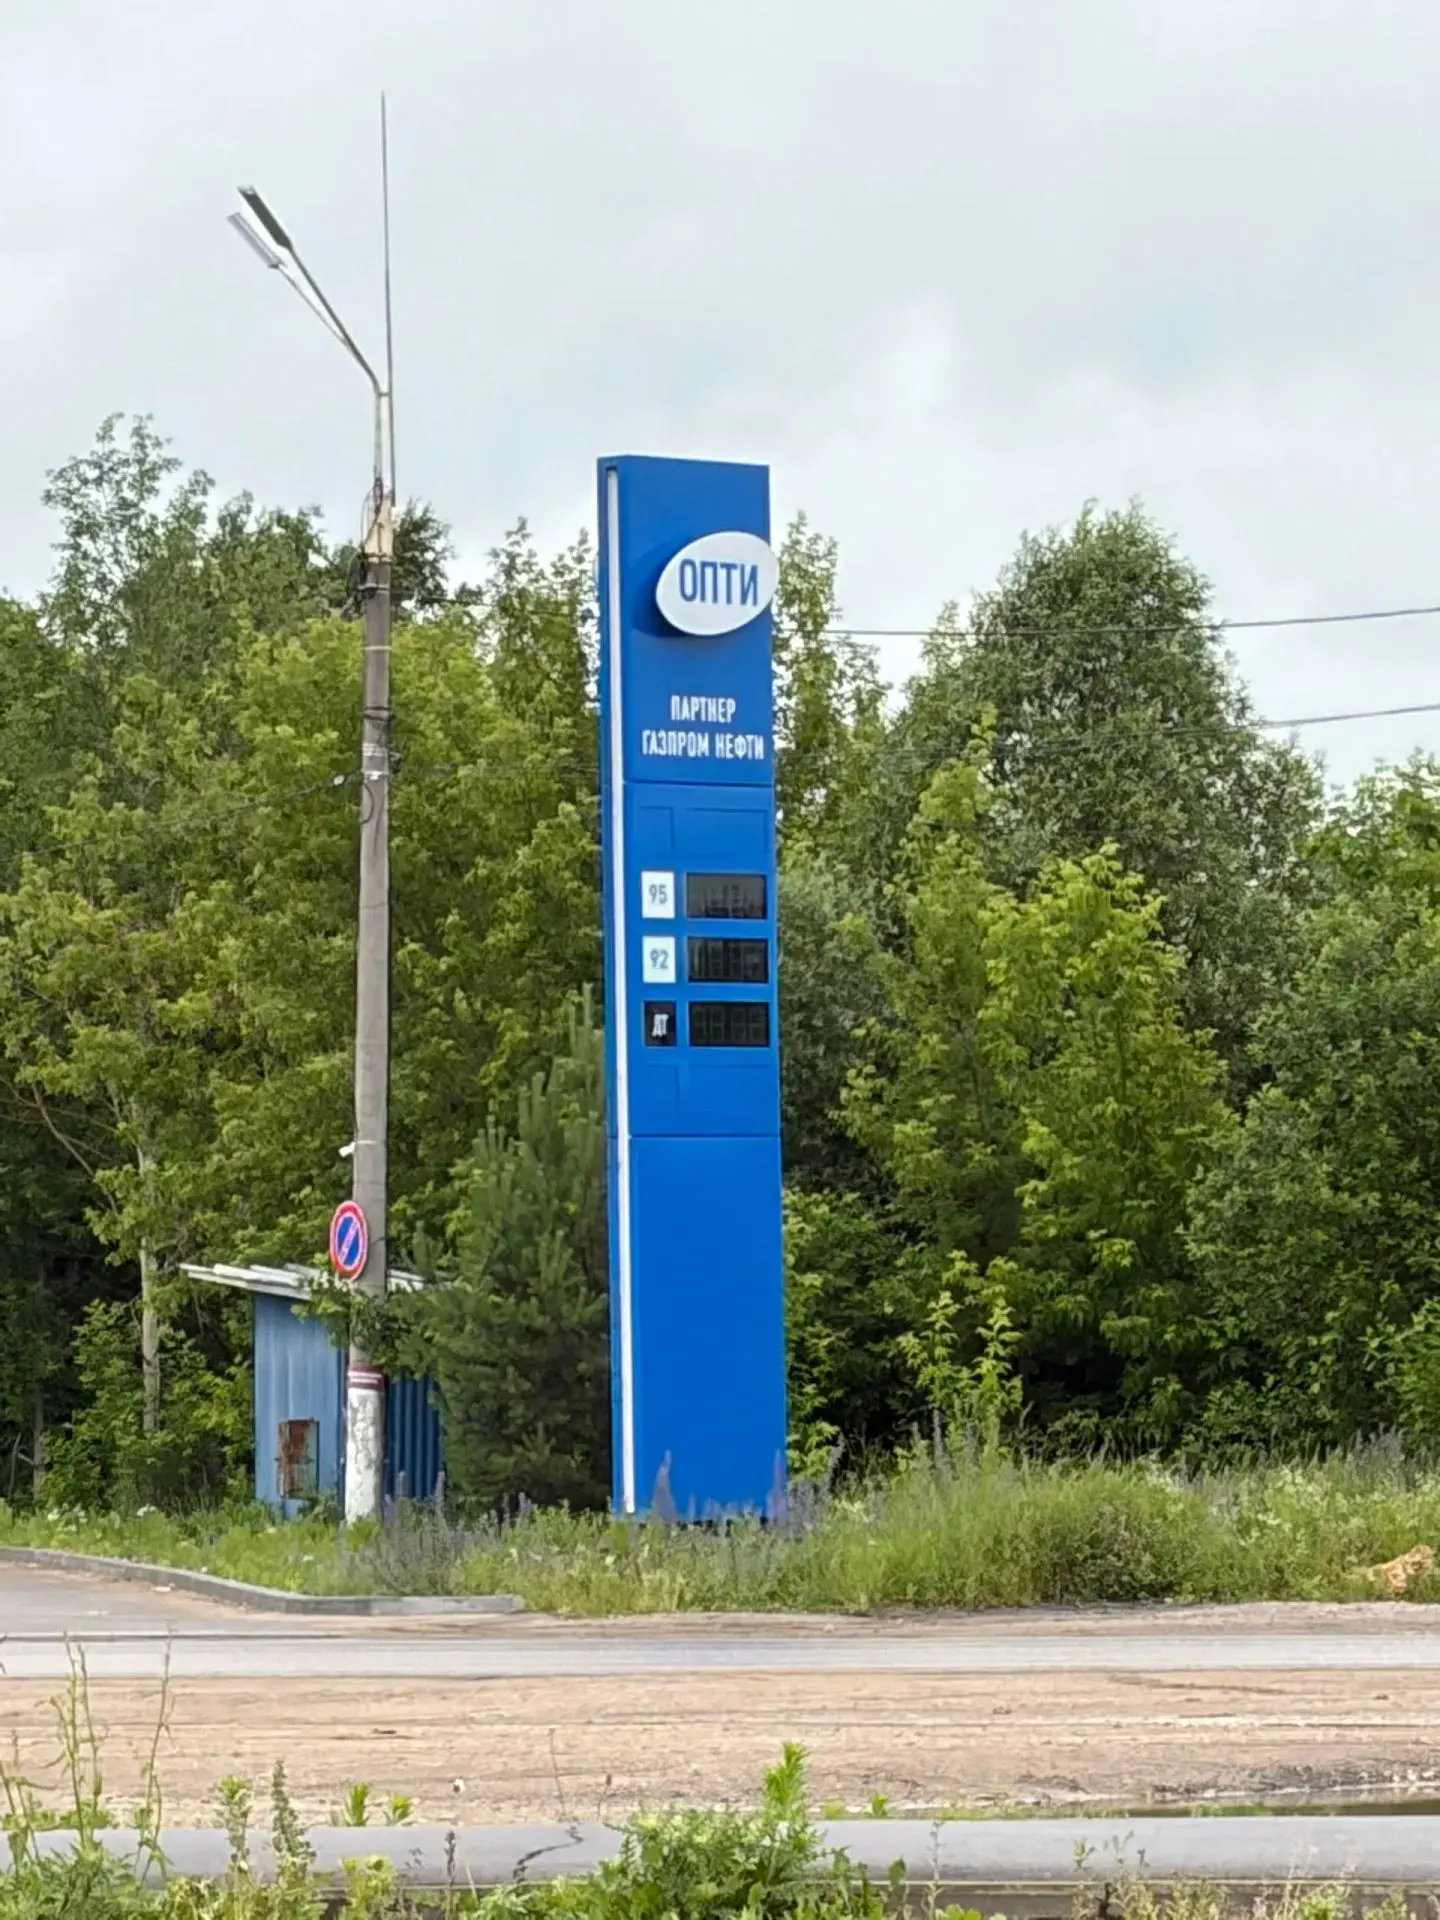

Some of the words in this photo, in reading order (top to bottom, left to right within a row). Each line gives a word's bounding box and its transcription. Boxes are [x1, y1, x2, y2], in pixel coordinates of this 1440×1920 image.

[679, 558, 758, 606] ОПТИ
[671, 695, 735, 723] ПАРТНЕР
[642, 729, 709, 757] ГАЗПРОМ
[714, 734, 764, 760] НЕФТИ
[648, 884, 667, 904] 95
[650, 948, 669, 969] 92
